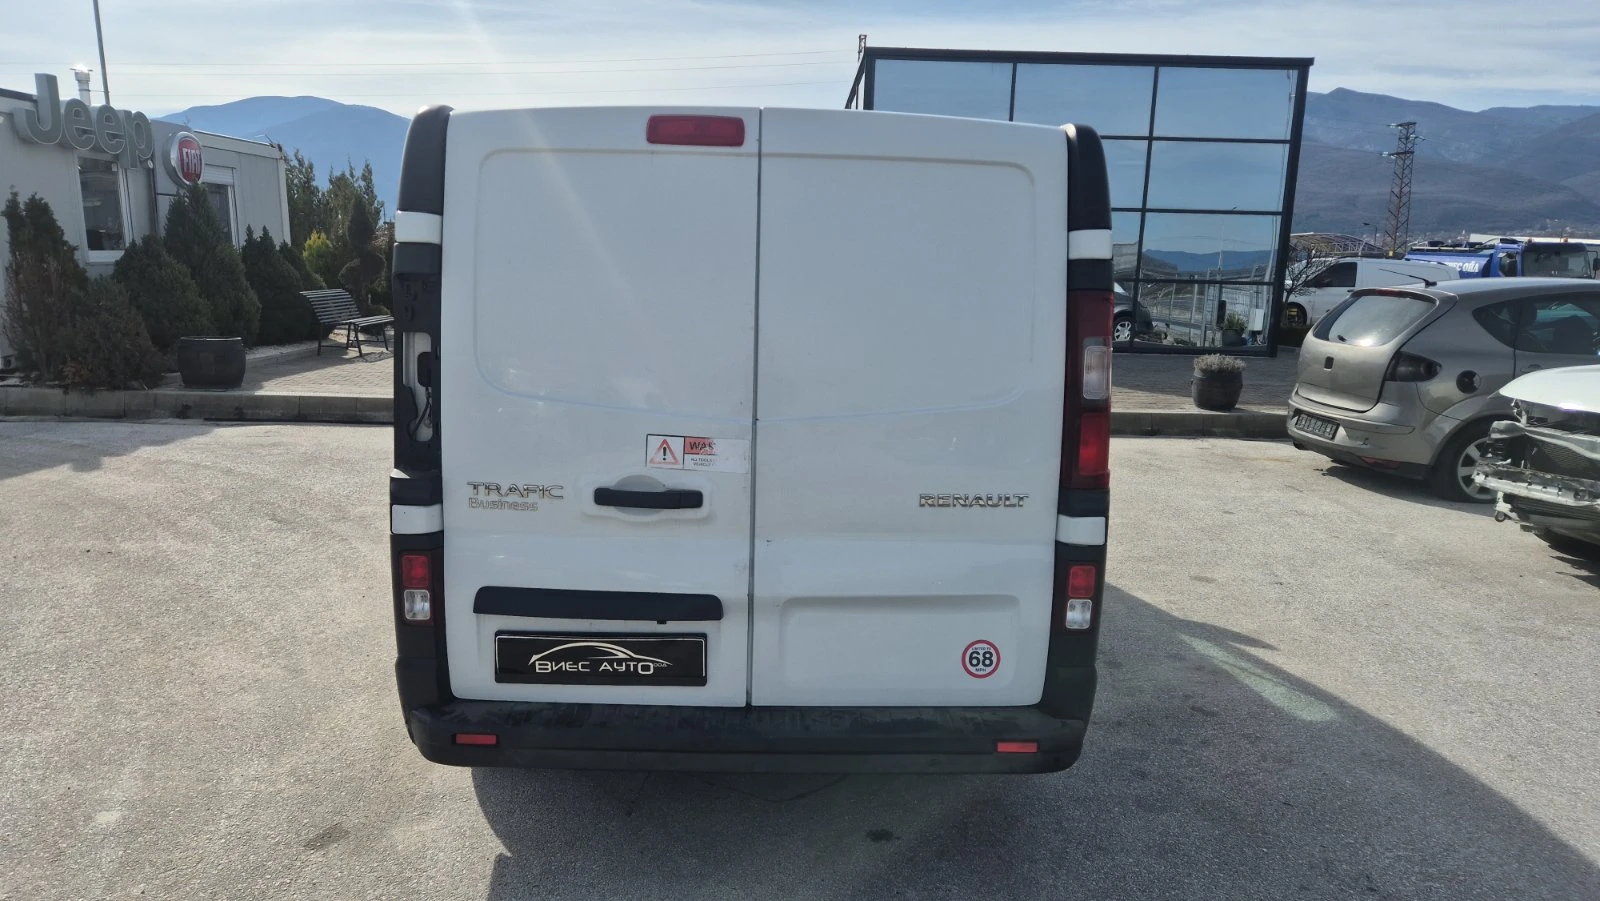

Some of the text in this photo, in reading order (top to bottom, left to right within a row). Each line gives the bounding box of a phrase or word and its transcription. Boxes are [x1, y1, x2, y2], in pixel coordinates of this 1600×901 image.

[13, 73, 154, 168] Jeep
[183, 147, 201, 174] FIAT
[467, 482, 564, 499] TRAFIC
[468, 497, 539, 512] Business
[918, 493, 1030, 508] RENAULT
[969, 650, 993, 668] 68
